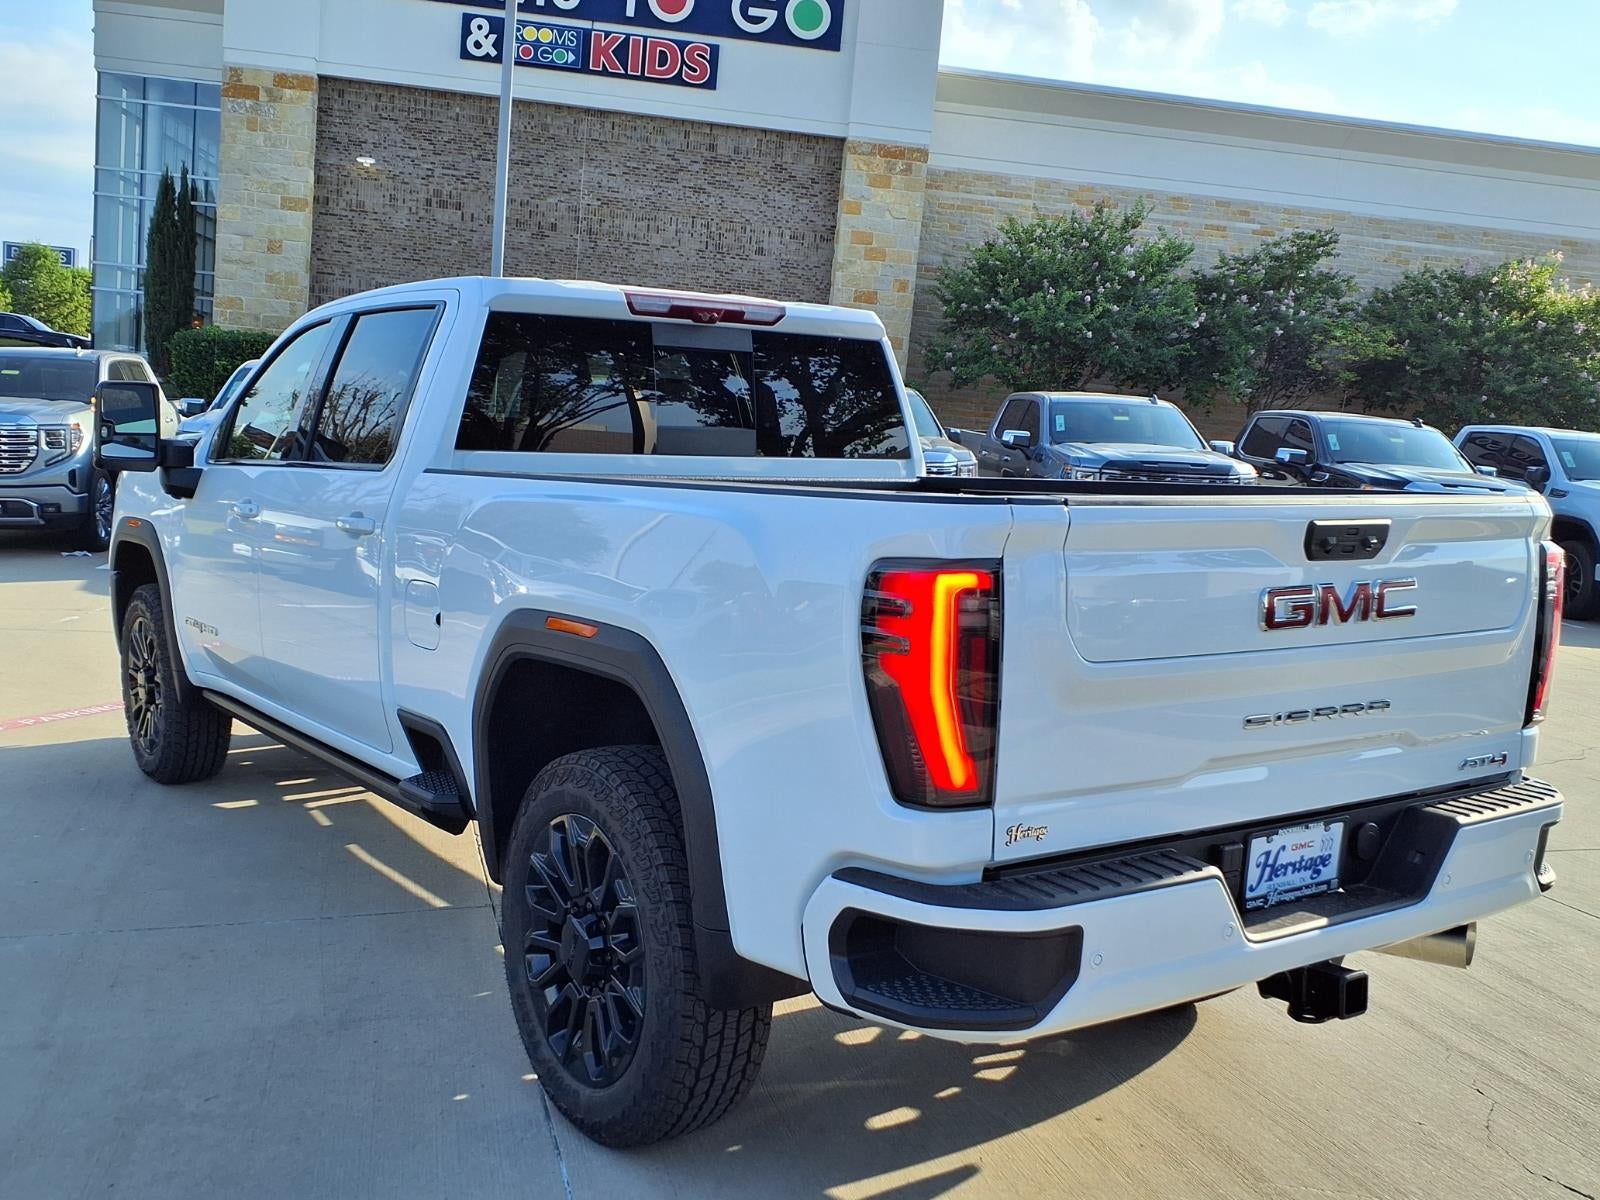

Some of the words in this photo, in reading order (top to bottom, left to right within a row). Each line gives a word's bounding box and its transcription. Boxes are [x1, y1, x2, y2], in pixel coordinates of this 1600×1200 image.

[731, 0, 832, 40] GO
[466, 17, 498, 58] &
[515, 25, 577, 47] ROOMS
[514, 43, 534, 60] TO
[537, 46, 568, 64] GO
[589, 31, 711, 84] KIDS
[1259, 577, 1417, 631] GMC
[1243, 699, 1391, 730] SIERRA
[1457, 752, 1508, 770] AT4
[1005, 823, 1048, 847] Heritage
[1291, 841, 1315, 852] GMC
[1248, 845, 1332, 893] Heritage
